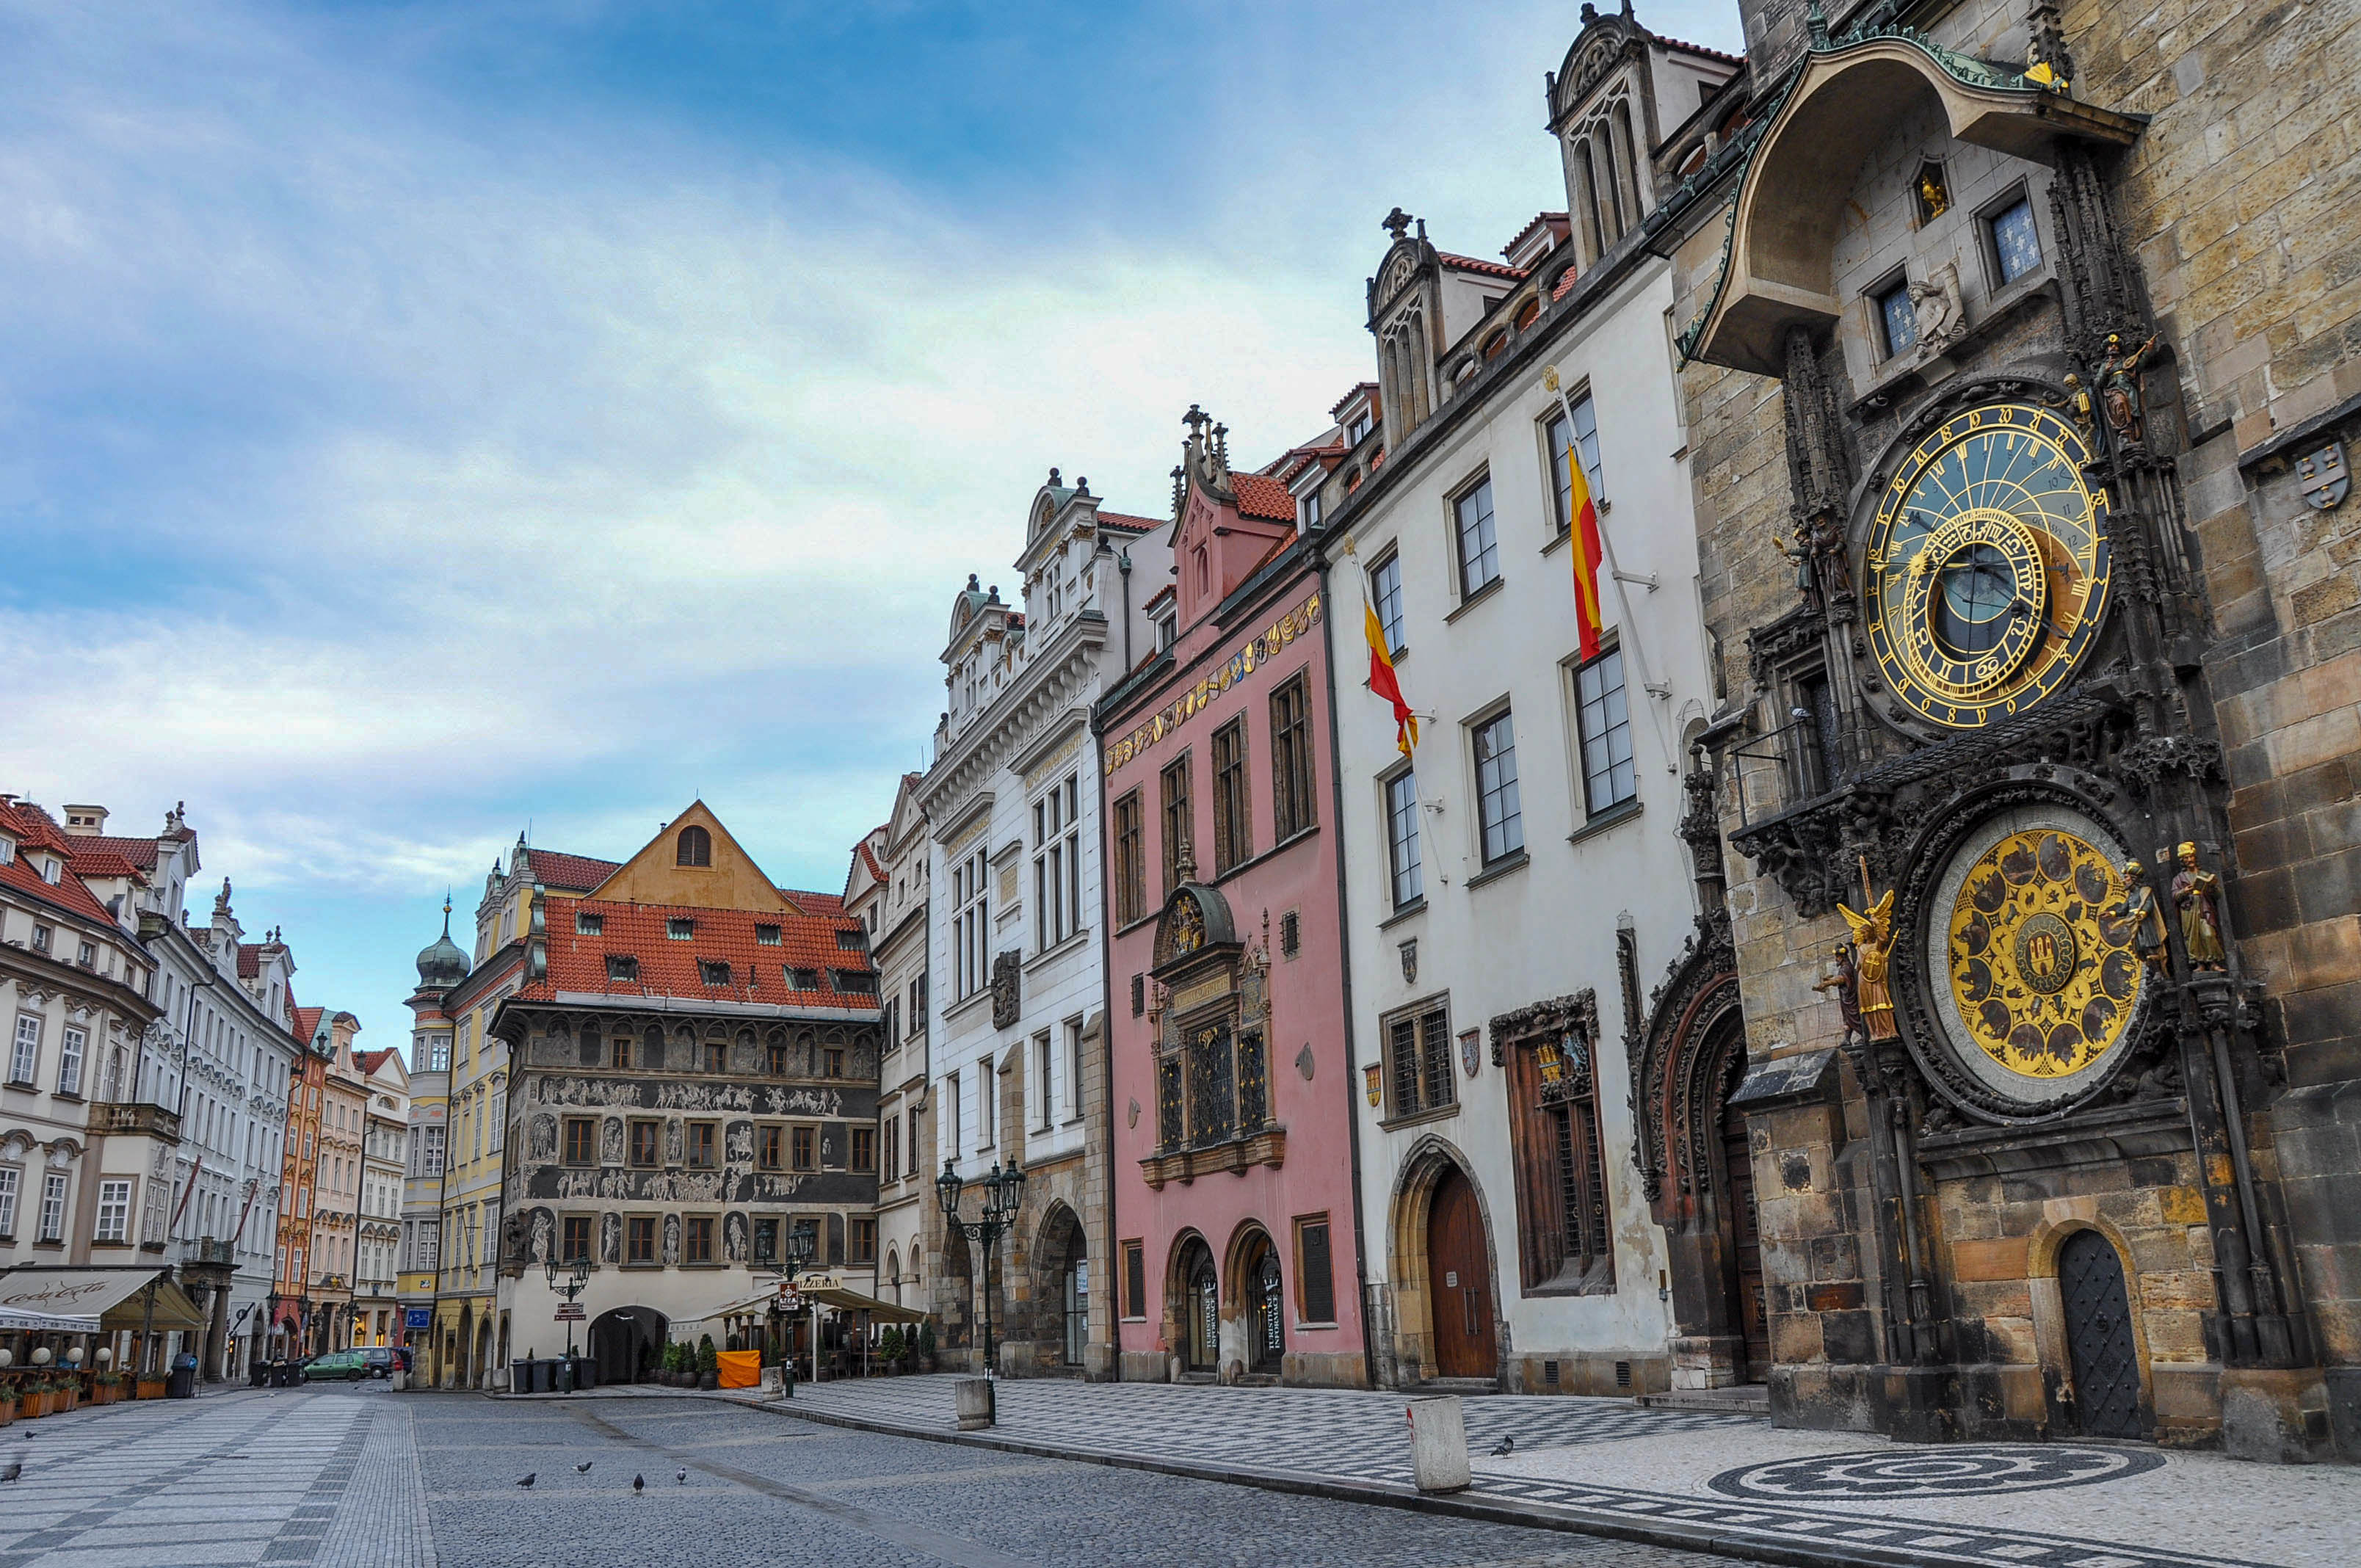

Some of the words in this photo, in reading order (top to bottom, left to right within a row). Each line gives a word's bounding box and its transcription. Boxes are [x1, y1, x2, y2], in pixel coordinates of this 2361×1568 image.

[2048, 476, 2059, 490] 10
[2062, 504, 2071, 515] 11
[2067, 534, 2078, 548] 12
[799, 1279, 839, 1288] IZZERIA
